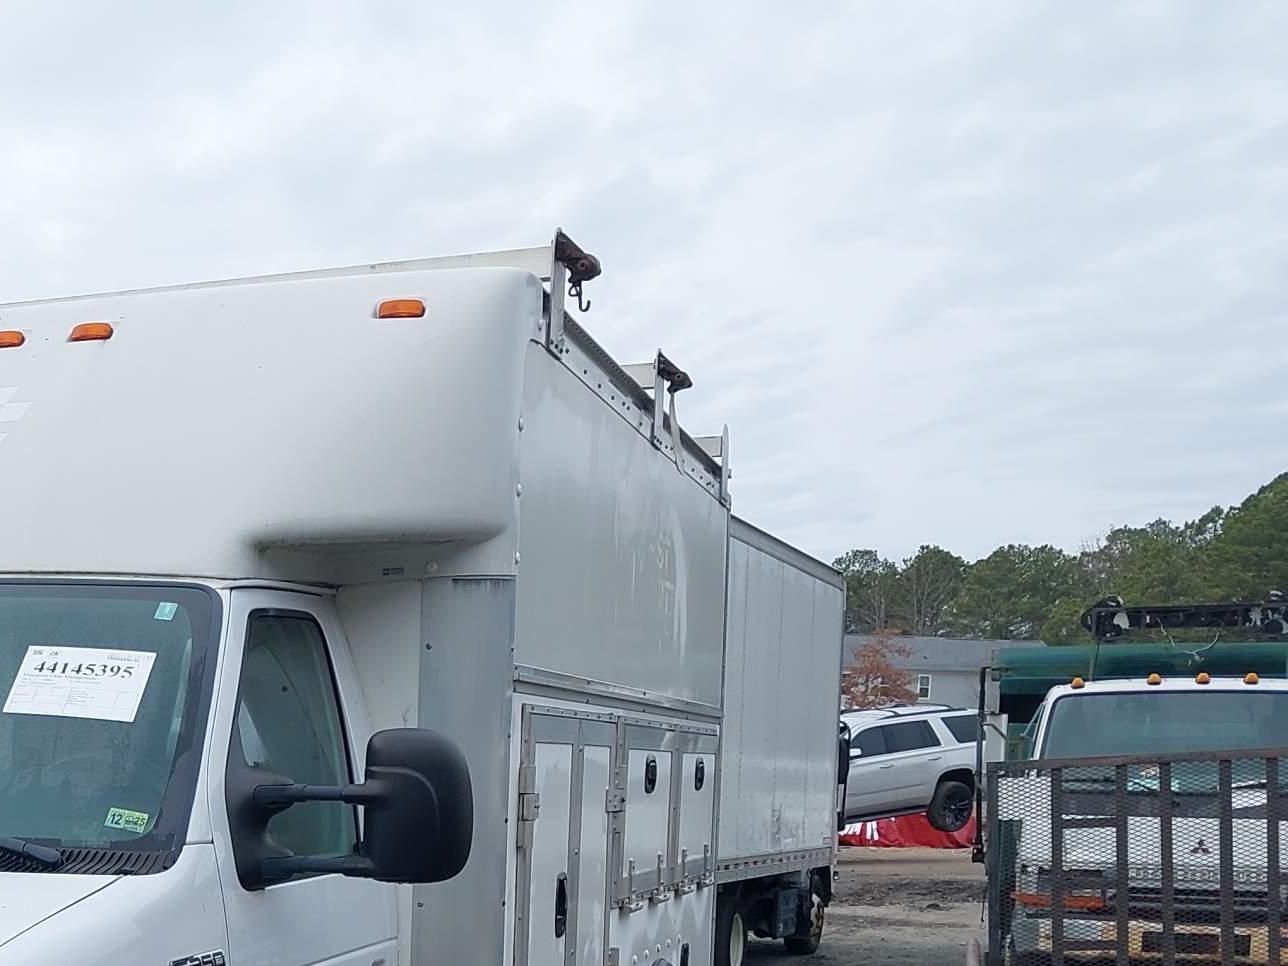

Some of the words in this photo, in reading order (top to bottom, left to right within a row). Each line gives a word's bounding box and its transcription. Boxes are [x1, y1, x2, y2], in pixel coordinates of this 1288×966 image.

[33, 660, 136, 679] 44145395
[110, 813, 123, 826] 12
[134, 816, 145, 827] 25
